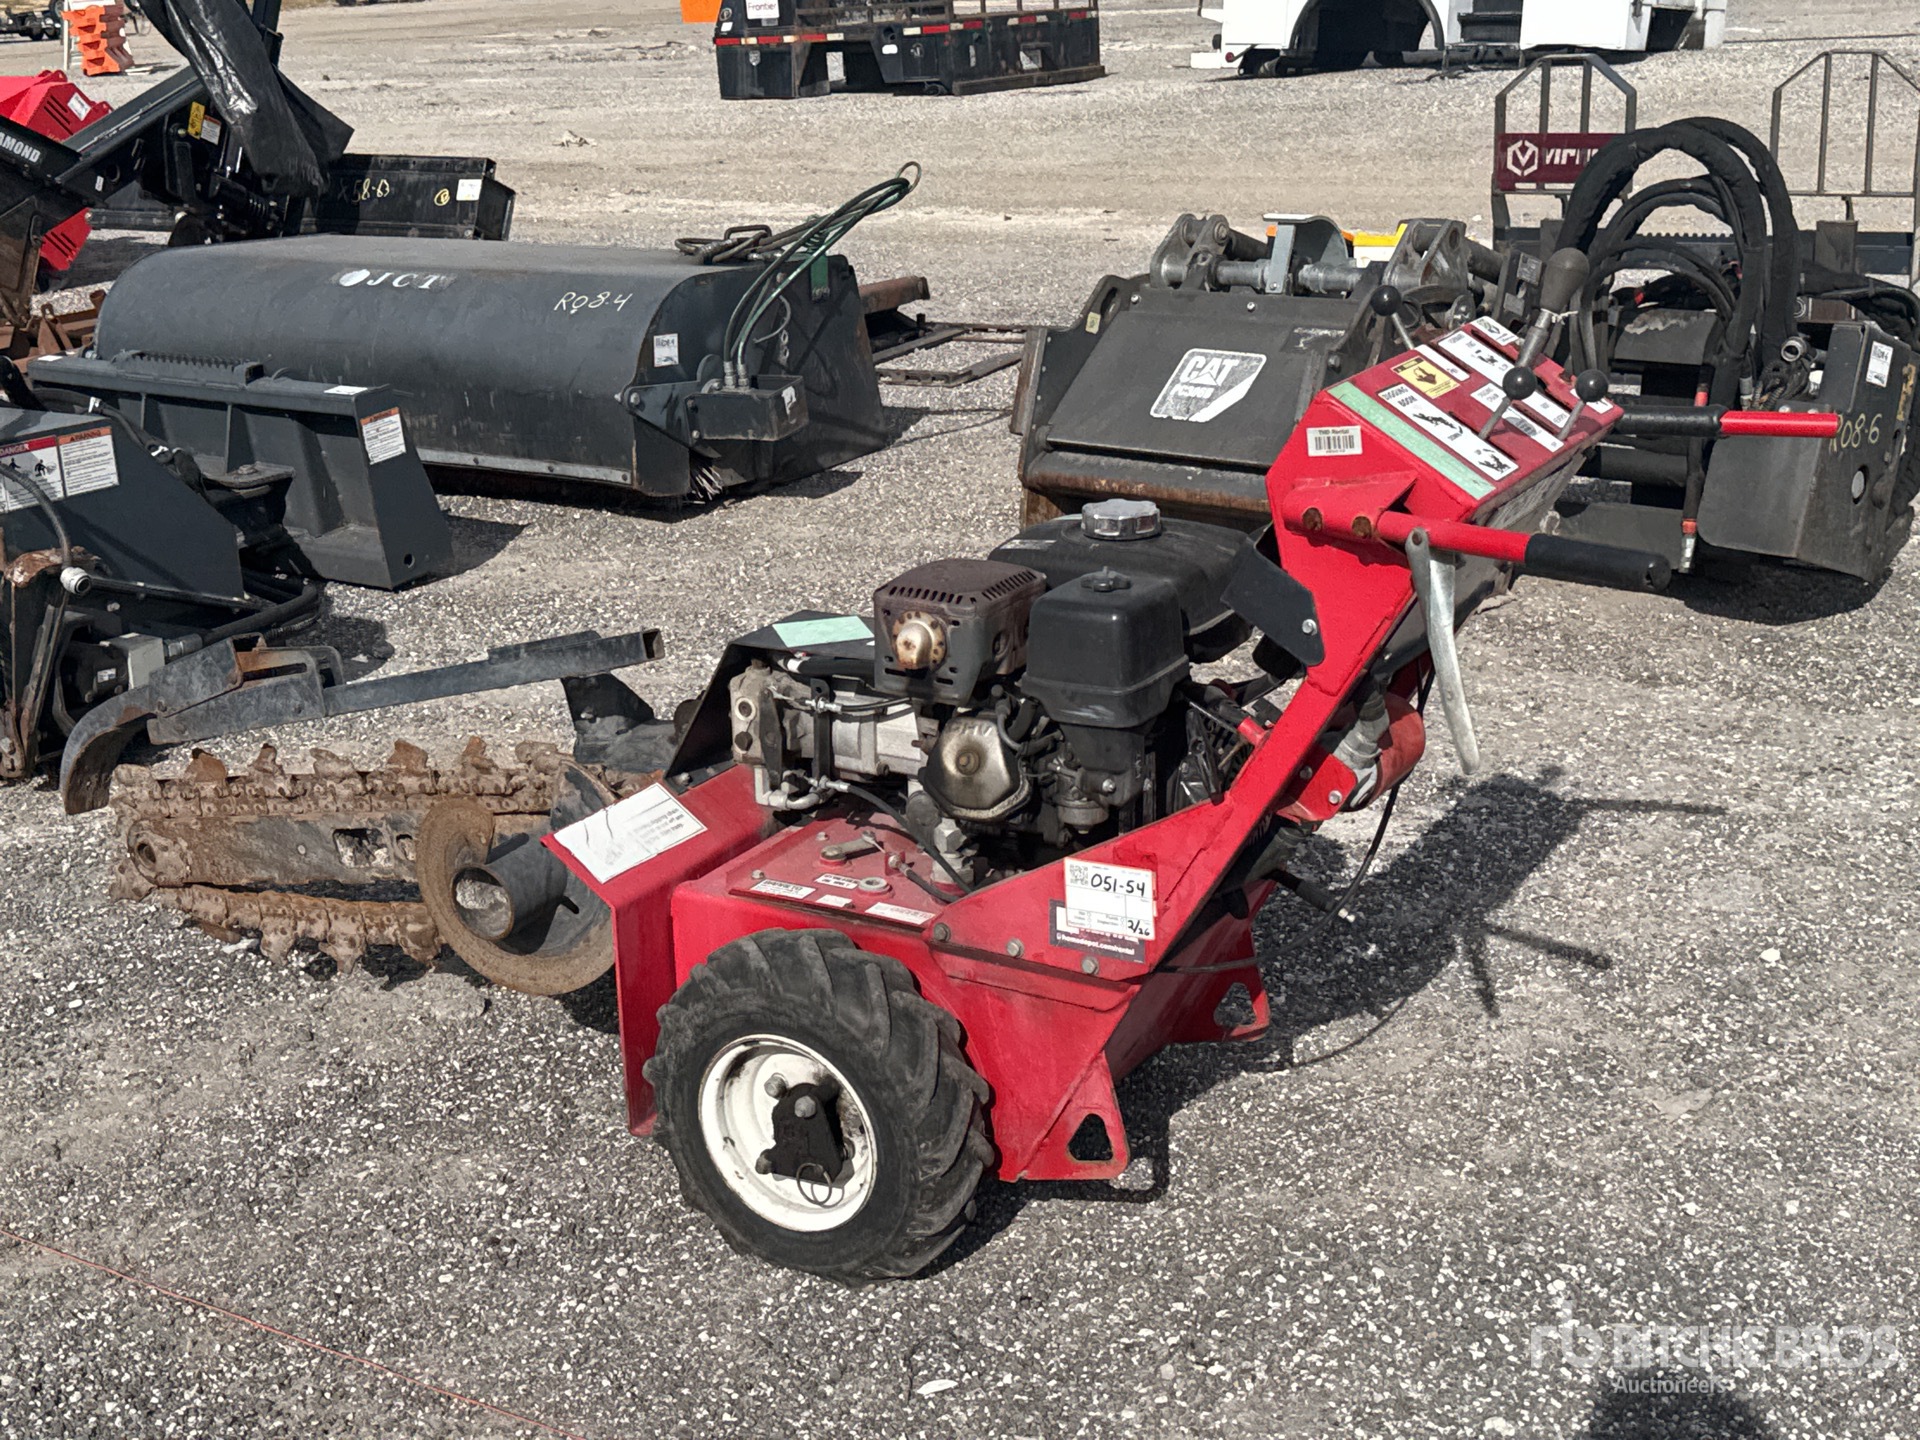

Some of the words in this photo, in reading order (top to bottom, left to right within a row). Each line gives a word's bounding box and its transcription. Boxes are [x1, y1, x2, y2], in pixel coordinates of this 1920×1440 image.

[748, 1, 777, 12] Frontier
[1179, 355, 1240, 387] CAT
[0, 443, 30, 457] DANGER
[1090, 873, 1145, 897] 051-54
